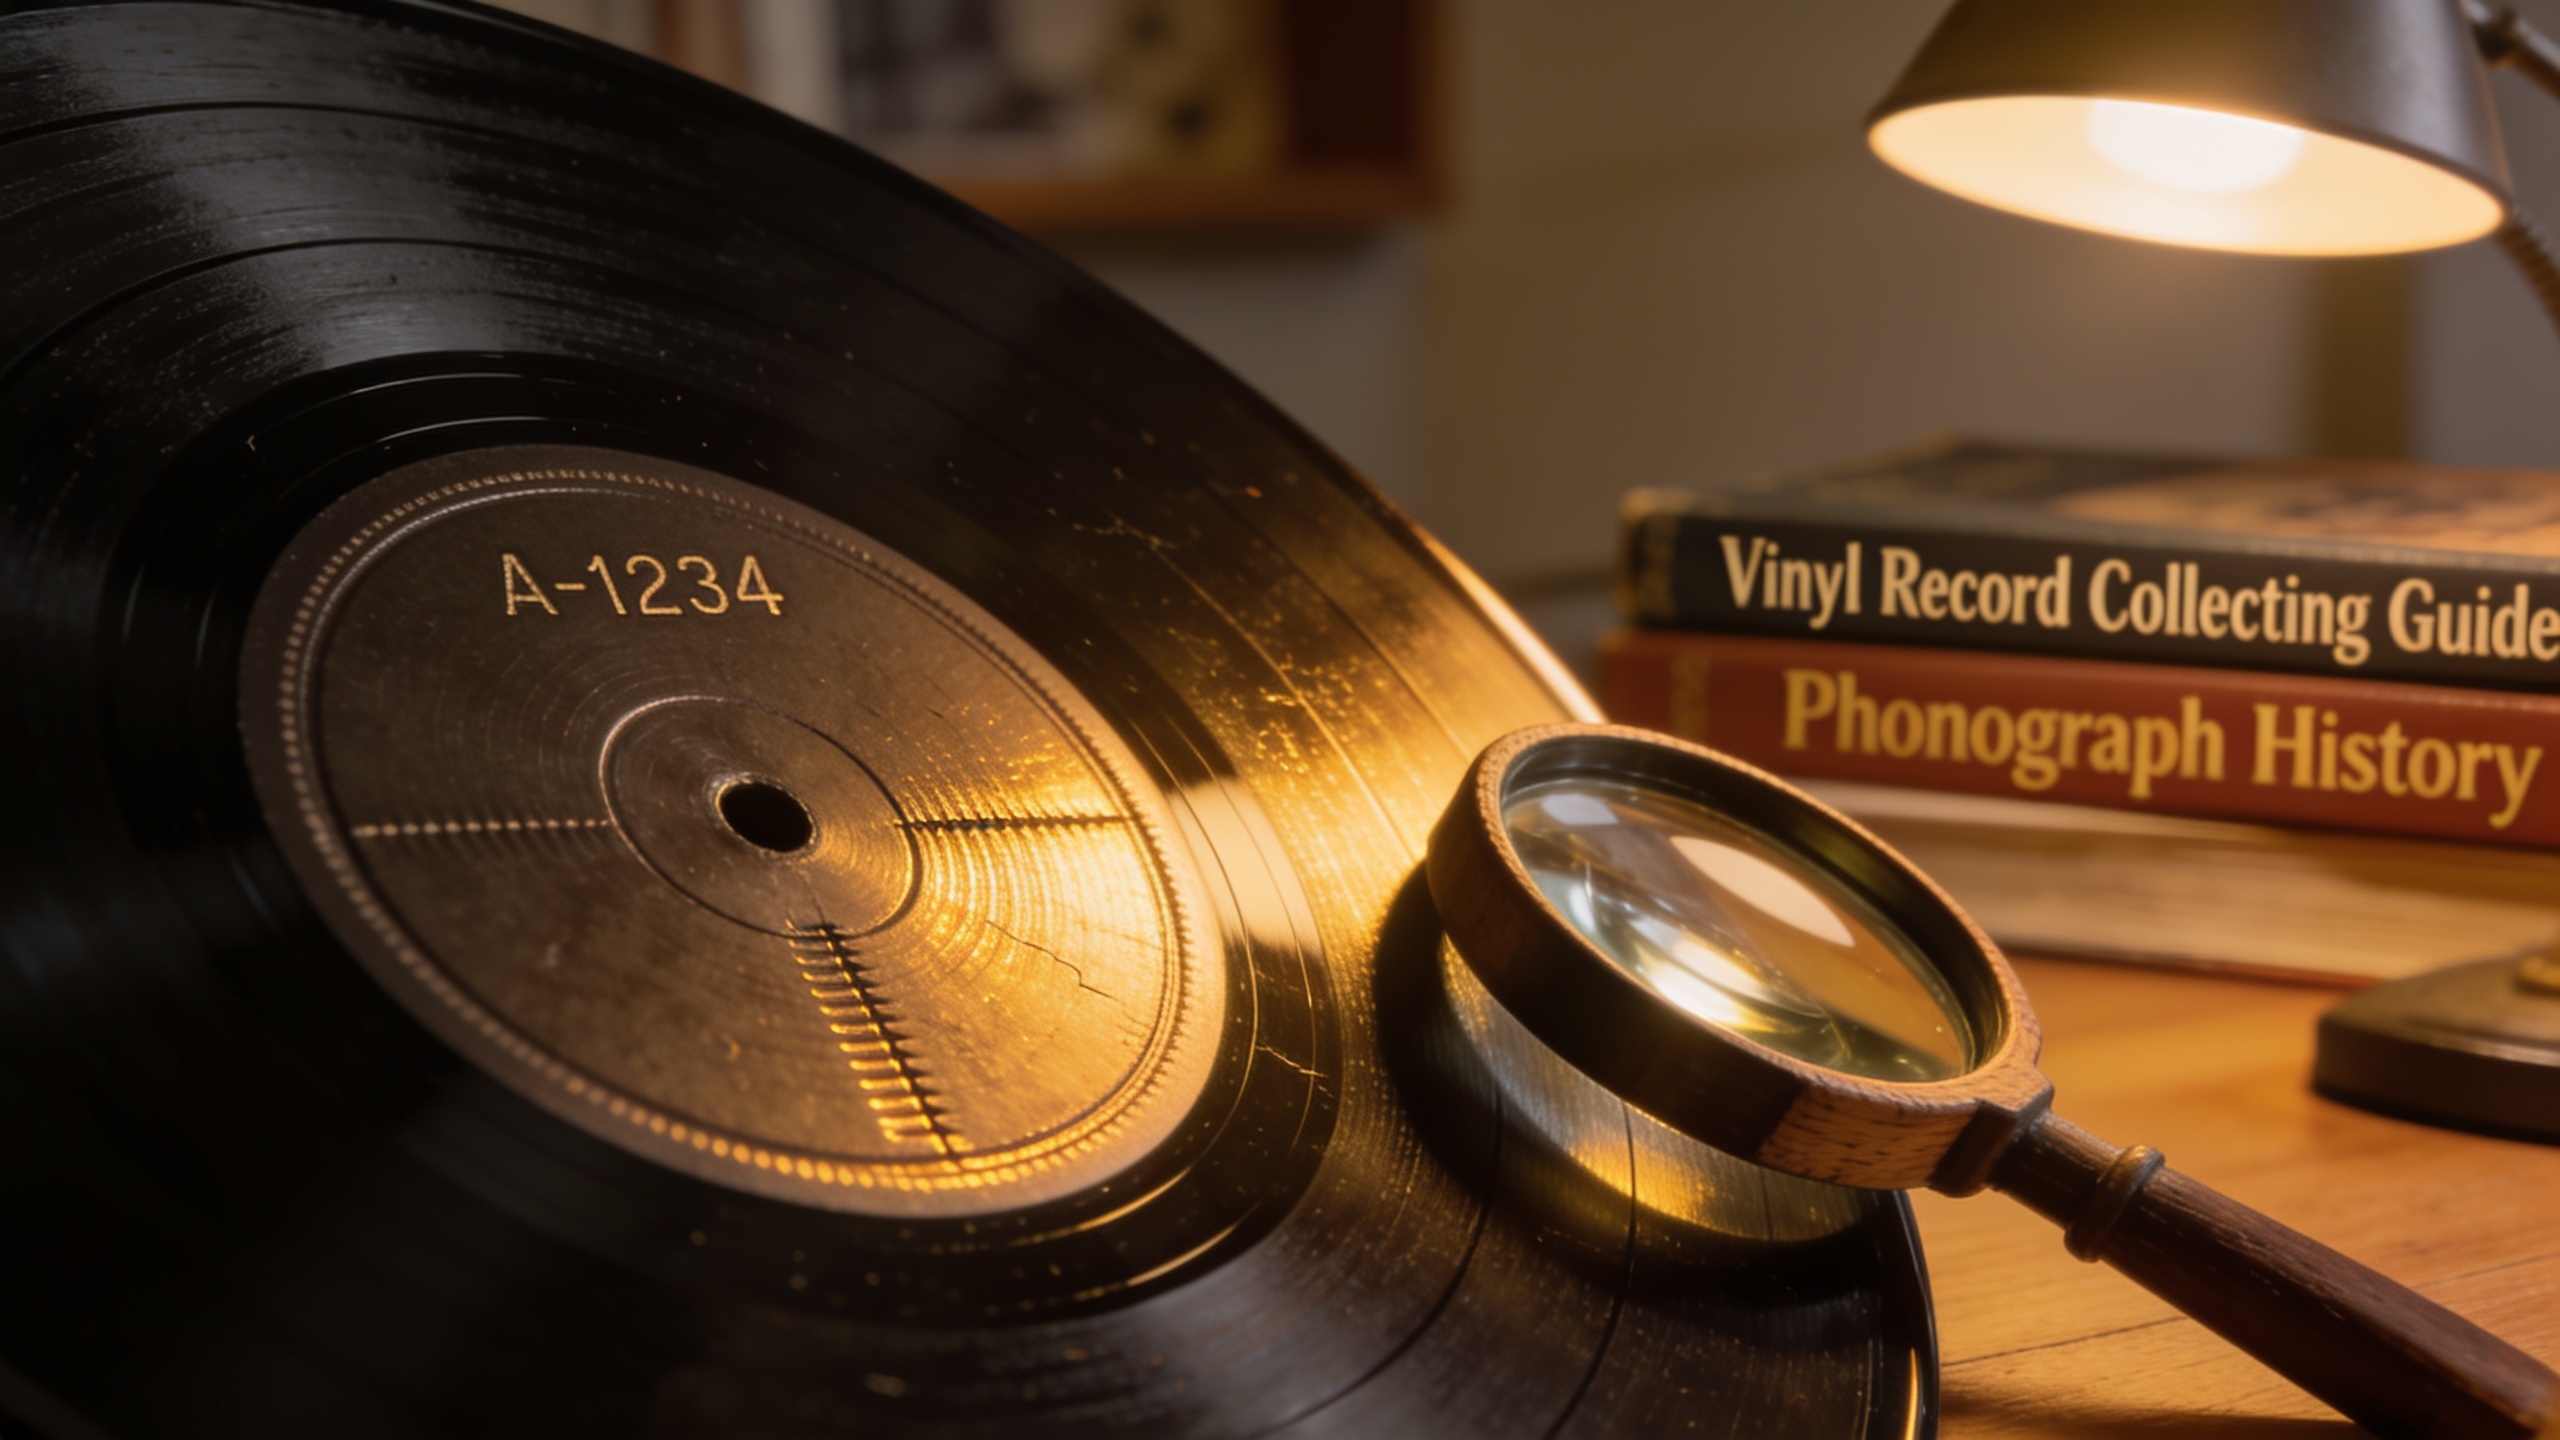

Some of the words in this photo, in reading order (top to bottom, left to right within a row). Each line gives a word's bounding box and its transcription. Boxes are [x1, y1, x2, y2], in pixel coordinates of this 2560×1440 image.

[502, 553, 784, 616] A-1234
[1720, 535, 1862, 629] Vinyl
[1880, 547, 2071, 627] Record
[2088, 558, 2371, 666] Collecting
[2388, 578, 2560, 661] Guide
[1783, 669, 2225, 799] Phonograph
[2251, 702, 2543, 829] History
